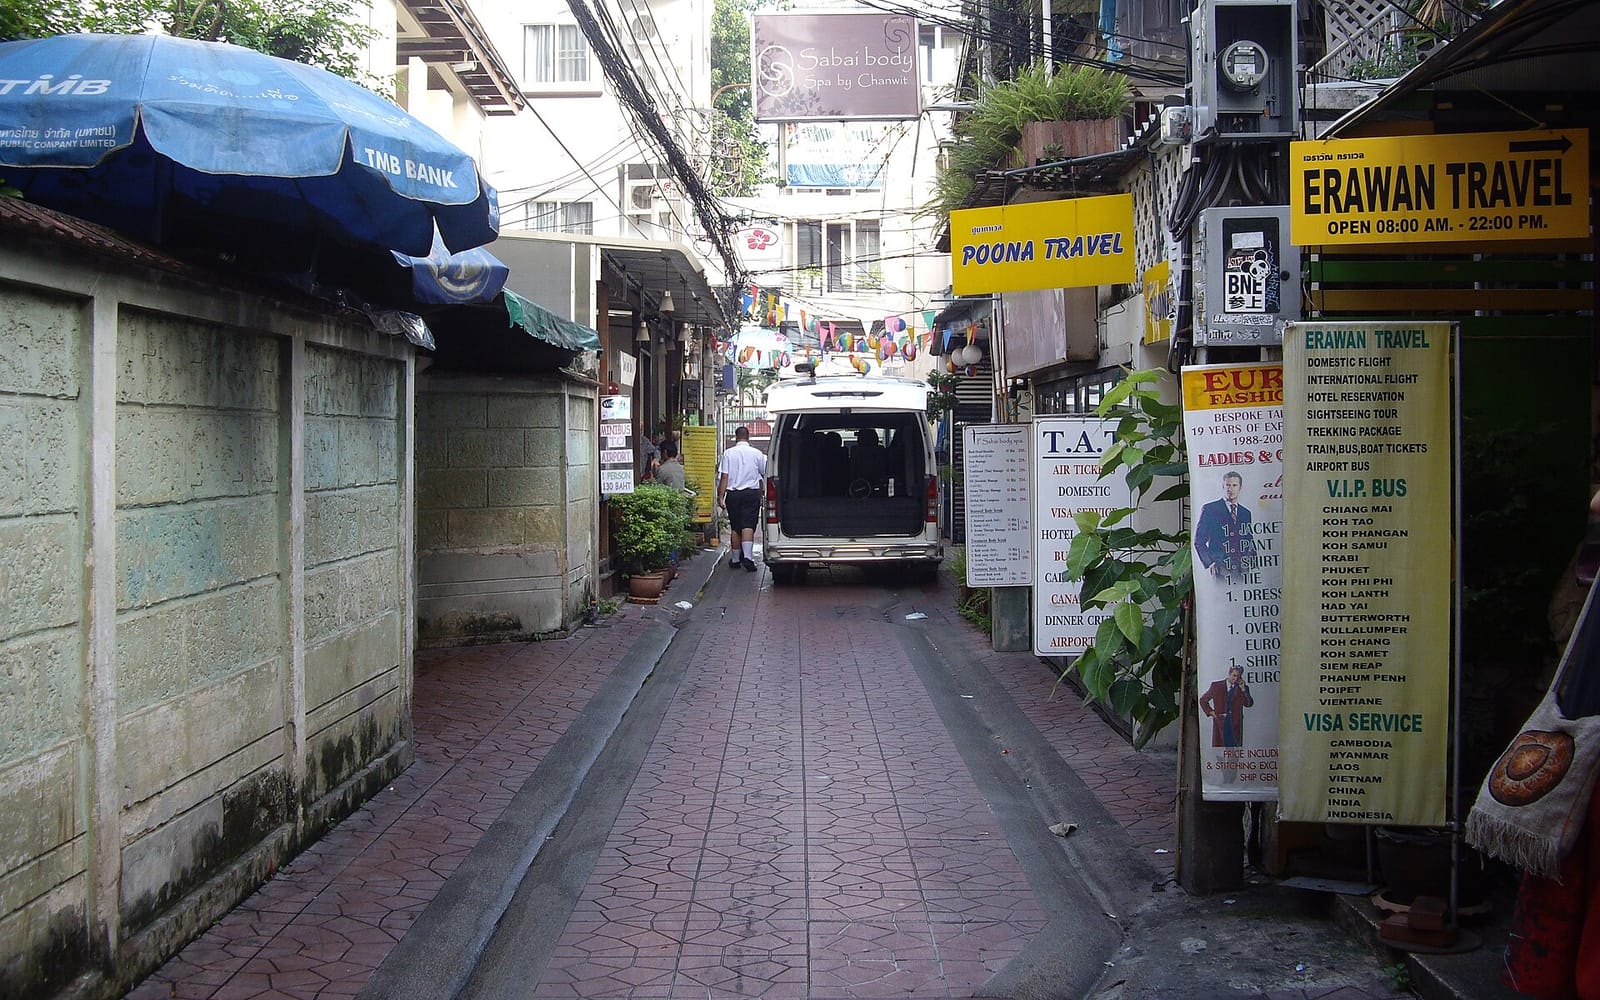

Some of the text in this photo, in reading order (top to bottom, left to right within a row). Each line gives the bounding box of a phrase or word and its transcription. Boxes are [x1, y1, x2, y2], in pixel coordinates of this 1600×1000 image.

[798, 46, 914, 72] Sabai body
[0, 74, 112, 95] TMB
[803, 73, 908, 90] Spa by Chanwit
[0, 139, 116, 148] PUBLIC COMPANY LIMITED
[364, 148, 458, 188] TMB BANK
[1304, 158, 1572, 215] ERAWAN TRAVEL
[1328, 220, 1371, 235] OPEN
[1376, 218, 1418, 234] 08:00
[1424, 217, 1454, 232] AM.
[1468, 216, 1513, 230] 22:00
[1518, 214, 1548, 229] PM.
[962, 232, 1124, 266] POONA TRAVEL
[1228, 275, 1262, 294] BNE
[1306, 330, 1430, 349] ERAWAN TRAVEL
[1308, 358, 1391, 368] DOMESTIC FLIGHT
[1308, 375, 1418, 384] INTERNATIONAL FLIGHT
[1308, 392, 1404, 402] HOTEL RESERVATION
[1214, 412, 1263, 422] BESPOKE
[1307, 410, 1398, 419] SIGHTSEEING TOUR
[601, 424, 630, 436] MINIBUS
[1192, 427, 1204, 436] 19
[1208, 425, 1242, 435] YEARS
[1246, 424, 1260, 432] OF
[1307, 427, 1402, 436] TREKKING PACKAGE
[609, 436, 624, 446] TO
[1307, 444, 1427, 456] TRAIN,BUS,BOAT TICKETS
[602, 451, 631, 462] AIRPORT
[1198, 450, 1255, 468] LADIES
[1258, 450, 1272, 464] &
[1053, 464, 1070, 475] AIR
[1306, 462, 1370, 471] AIRPORT BUS
[606, 472, 631, 480] PERSON
[603, 482, 631, 490] 130 BAHT
[1058, 486, 1111, 496] DOMESTIC
[1327, 479, 1406, 498] V.I.P. BUS
[1051, 508, 1072, 518] VISA
[1322, 506, 1392, 514] CHIANG MAI
[1222, 526, 1234, 536] 1.
[1322, 530, 1408, 538] KOH PHANGAN
[1223, 539, 1272, 554] 1. PANT
[1322, 542, 1388, 550] KOH SAMUI
[1224, 555, 1280, 570] 1. SHIRT
[1226, 572, 1262, 586] 1. TIE
[1322, 578, 1393, 586] KOH PHI PHI
[1052, 594, 1080, 604] CANA
[1226, 591, 1238, 602] 1.
[1322, 590, 1346, 598] KOH
[1244, 605, 1279, 618] EURO
[1046, 616, 1084, 626] DINNER
[1228, 622, 1281, 635] 1. OVER
[1050, 636, 1094, 647] AIRPORT
[1246, 638, 1280, 651] EURO
[1230, 657, 1240, 668] 1.
[1320, 662, 1382, 670] SIEM REAP
[1320, 686, 1361, 694] POIPET
[1304, 713, 1422, 732] VISA SERVICE
[1330, 740, 1392, 748] CAMBODIA
[1224, 748, 1244, 758] PRICE
[1206, 762, 1213, 770] &
[1216, 761, 1256, 770] STITCHING
[1240, 773, 1256, 782] SHIP
[1328, 787, 1366, 795] CHINA
[1328, 799, 1361, 807] INDIA
[1328, 811, 1393, 820] INDONESIA
